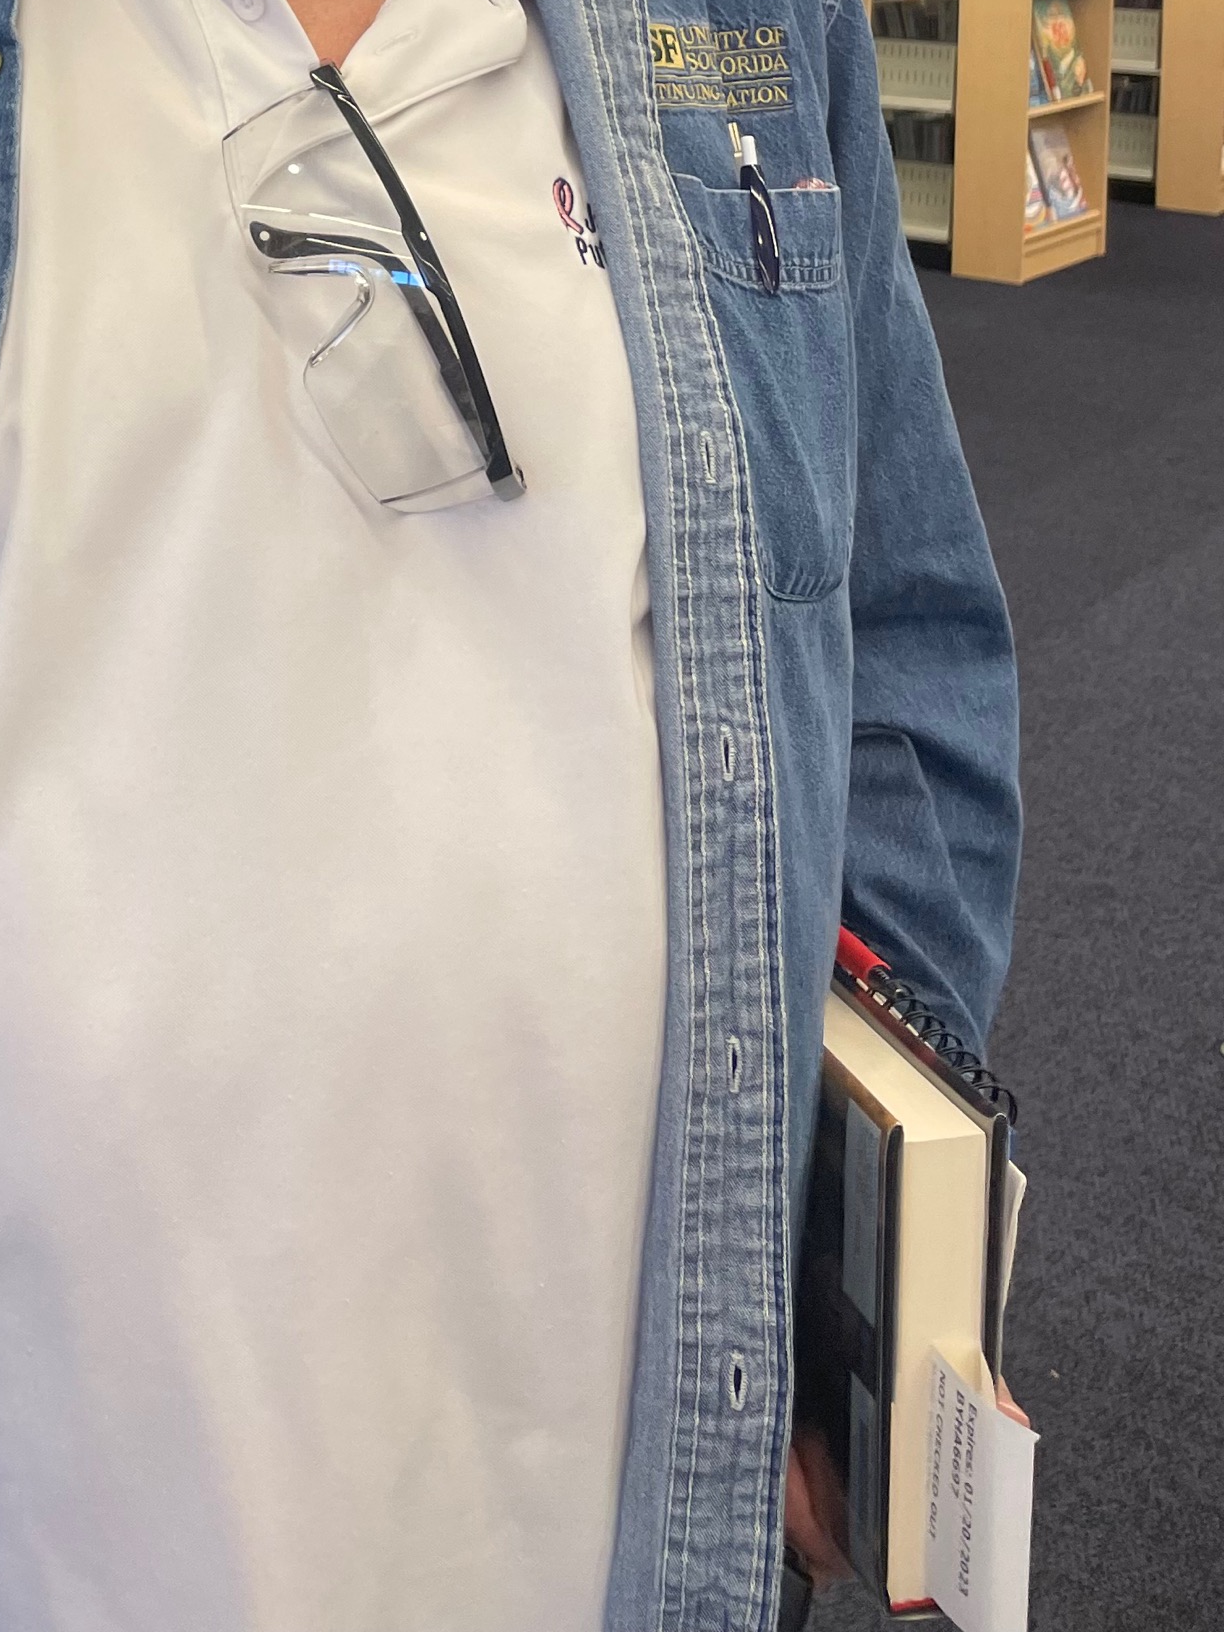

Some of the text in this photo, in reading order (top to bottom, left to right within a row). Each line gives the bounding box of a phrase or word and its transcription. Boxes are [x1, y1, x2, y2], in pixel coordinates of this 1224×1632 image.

[755, 26, 785, 46] OF
[928, 1369, 947, 1540] NOT CHECKED OUT
[963, 1402, 978, 1478] Expires:
